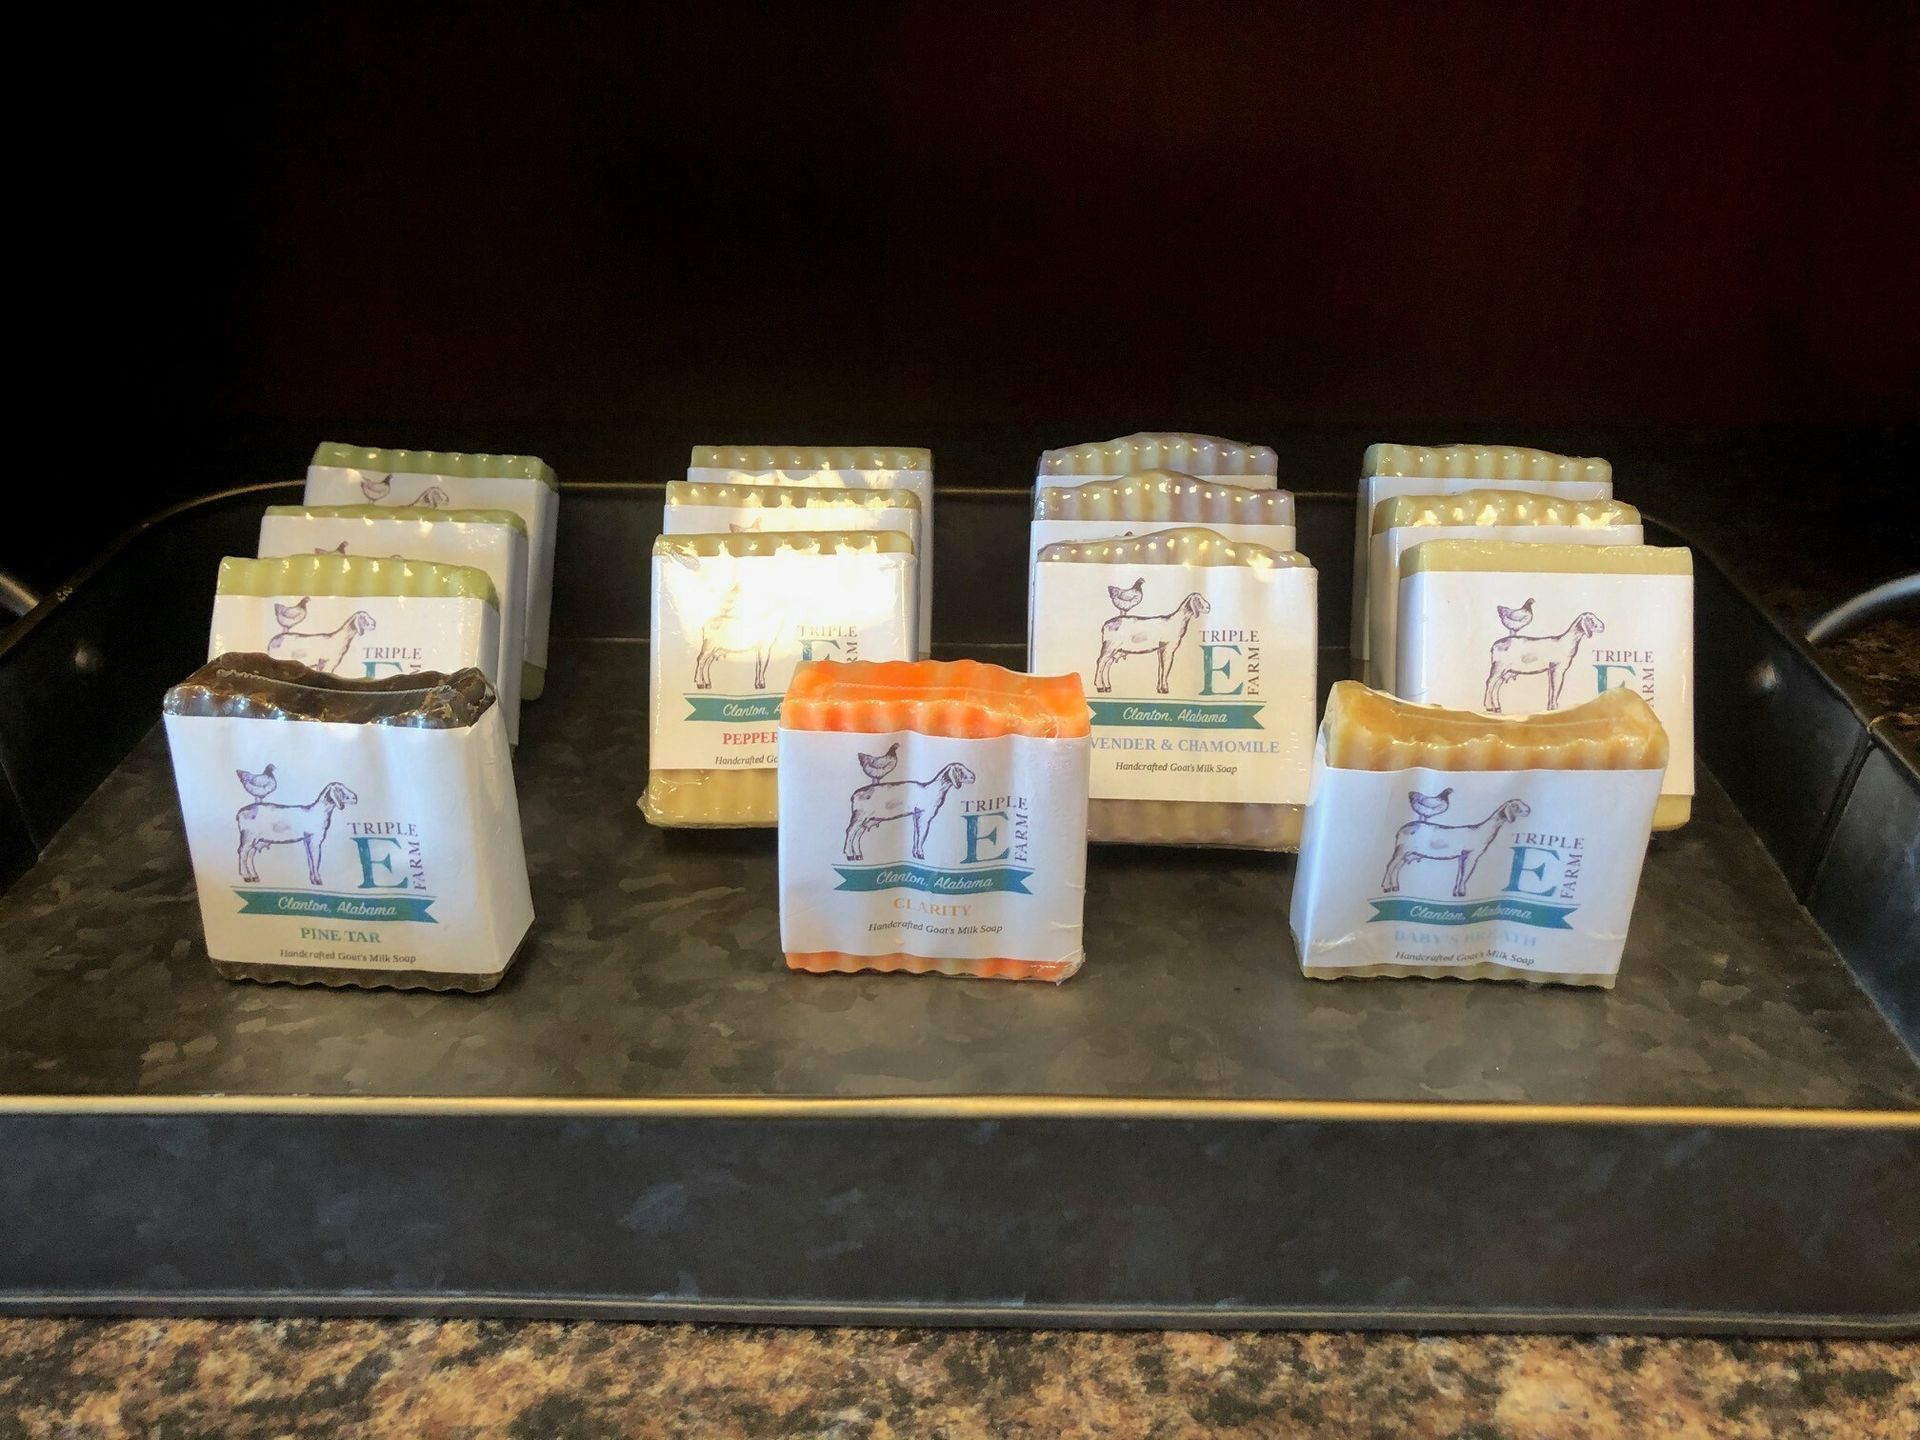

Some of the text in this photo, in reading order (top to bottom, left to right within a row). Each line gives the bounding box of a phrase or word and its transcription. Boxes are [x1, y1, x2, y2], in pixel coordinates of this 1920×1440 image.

[796, 624, 858, 637] TRIPLE
[1199, 629, 1260, 643] TRIPLE
[362, 647, 422, 660] TRIPLE
[1592, 649, 1654, 663] TRIPLE
[1198, 644, 1244, 696] E
[1247, 647, 1260, 696] FARM
[1177, 709, 1228, 724] Alabama
[722, 731, 778, 745] PEPPER
[1090, 737, 1281, 754] VENDER & CHAMOMILE
[715, 754, 765, 766] Handcrafted
[1115, 761, 1238, 776] Handcrafted Goat's Milk Soap
[960, 795, 1028, 813] TRIPLE
[347, 821, 418, 837] TRIPLE
[960, 811, 1010, 864] E
[1015, 813, 1028, 862] FARM
[1512, 832, 1584, 850] TRIPLE
[350, 837, 408, 889] E
[408, 841, 427, 891] FARM
[1502, 846, 1561, 897] E
[1560, 853, 1583, 899] FARM
[934, 875, 994, 890] Alabama
[337, 902, 397, 916] Alabama
[892, 897, 972, 917] CLARITY
[300, 927, 381, 943] PINE TAR
[868, 919, 1003, 935] Handcrafted Goat's Milk Soap
[280, 949, 335, 961] Handcrafted
[369, 953, 390, 963] Milk
[393, 953, 417, 965] Soap
[1395, 950, 1454, 963] Handcrafted
[1486, 948, 1508, 961] Milk
[1510, 953, 1535, 966] Soap
